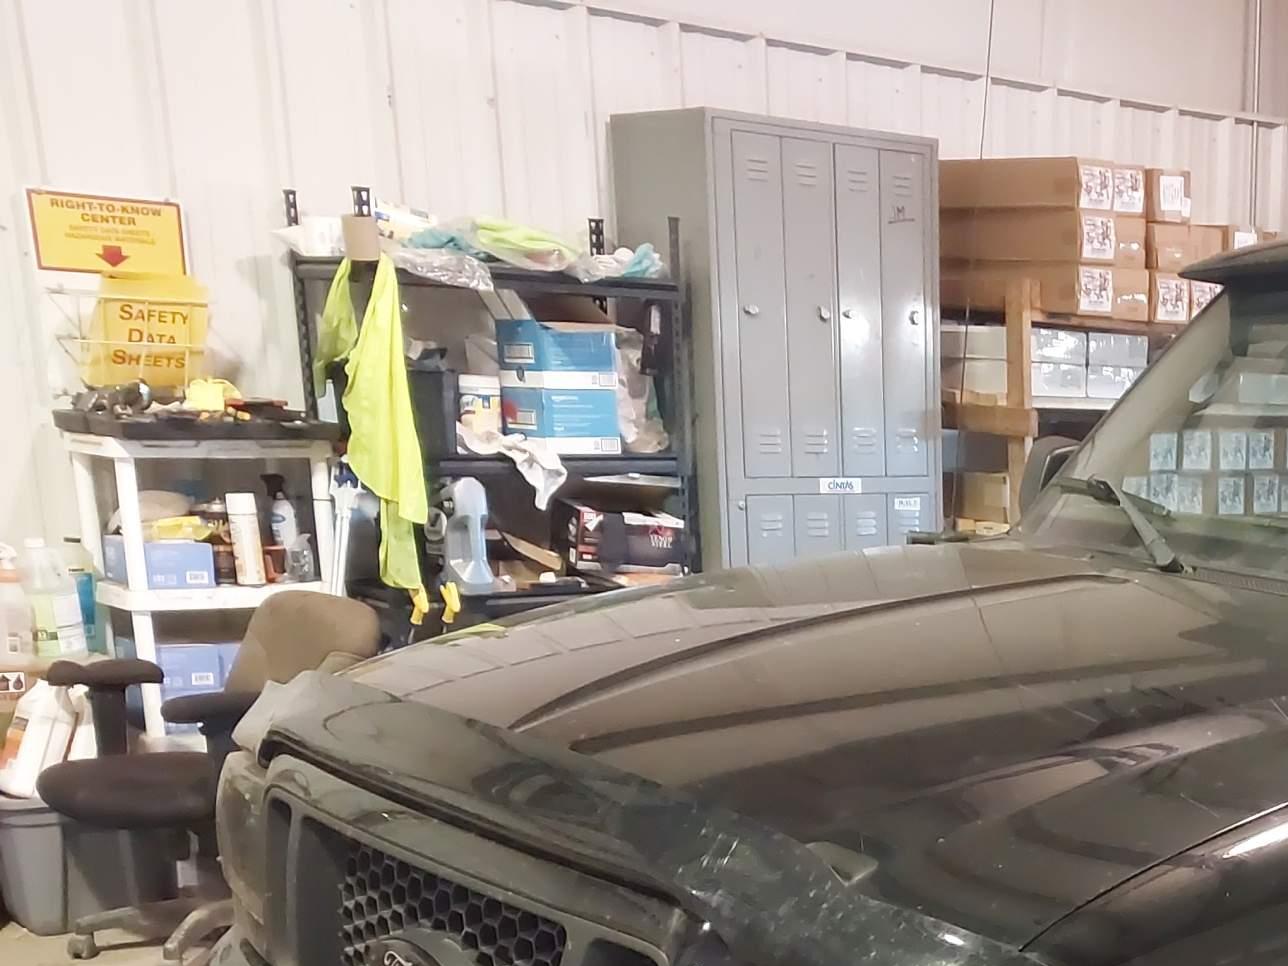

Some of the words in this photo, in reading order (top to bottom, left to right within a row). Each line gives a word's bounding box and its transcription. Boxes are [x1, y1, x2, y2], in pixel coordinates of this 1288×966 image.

[50, 198, 162, 216] RIGHT-TO-KNOW
[80, 213, 136, 226] CENTER
[119, 304, 188, 325] SAFETY
[128, 328, 177, 344] DATA
[111, 349, 185, 369] SHEETS
